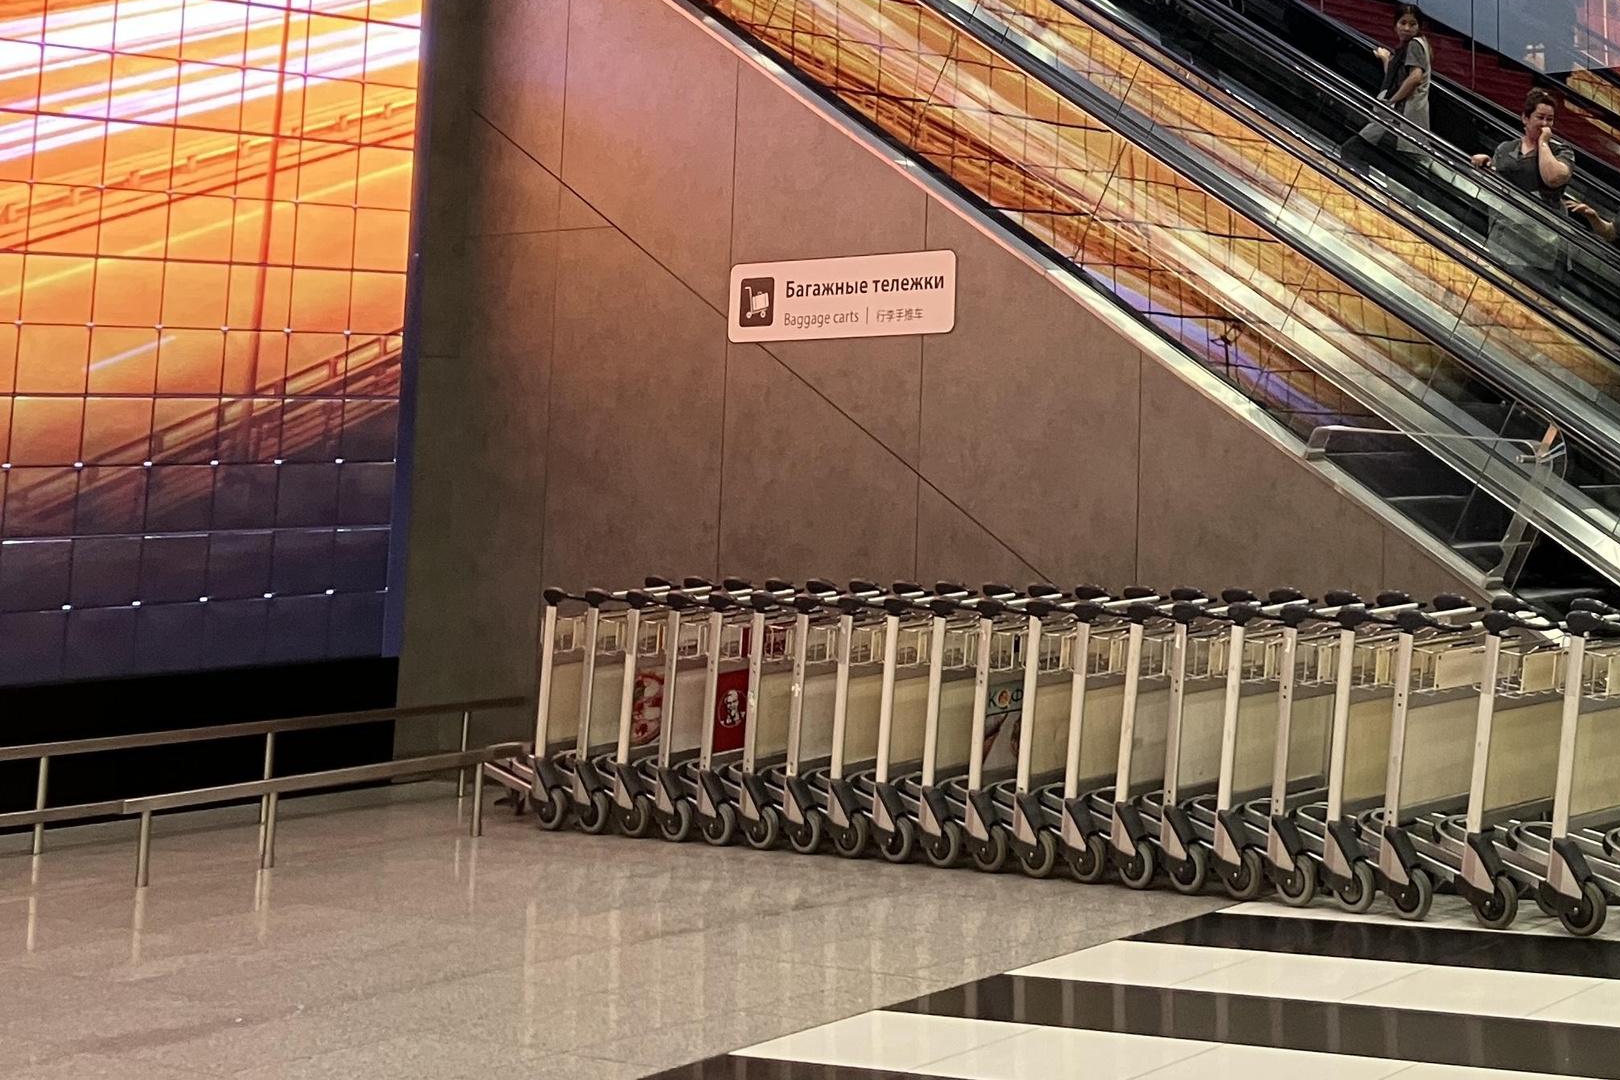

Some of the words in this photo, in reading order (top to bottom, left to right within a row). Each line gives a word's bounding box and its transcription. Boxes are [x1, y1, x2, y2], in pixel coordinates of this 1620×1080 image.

[785, 280, 869, 299] Багажные
[872, 275, 945, 293] тележки
[784, 312, 831, 329] Baggage
[833, 310, 859, 324] carts
